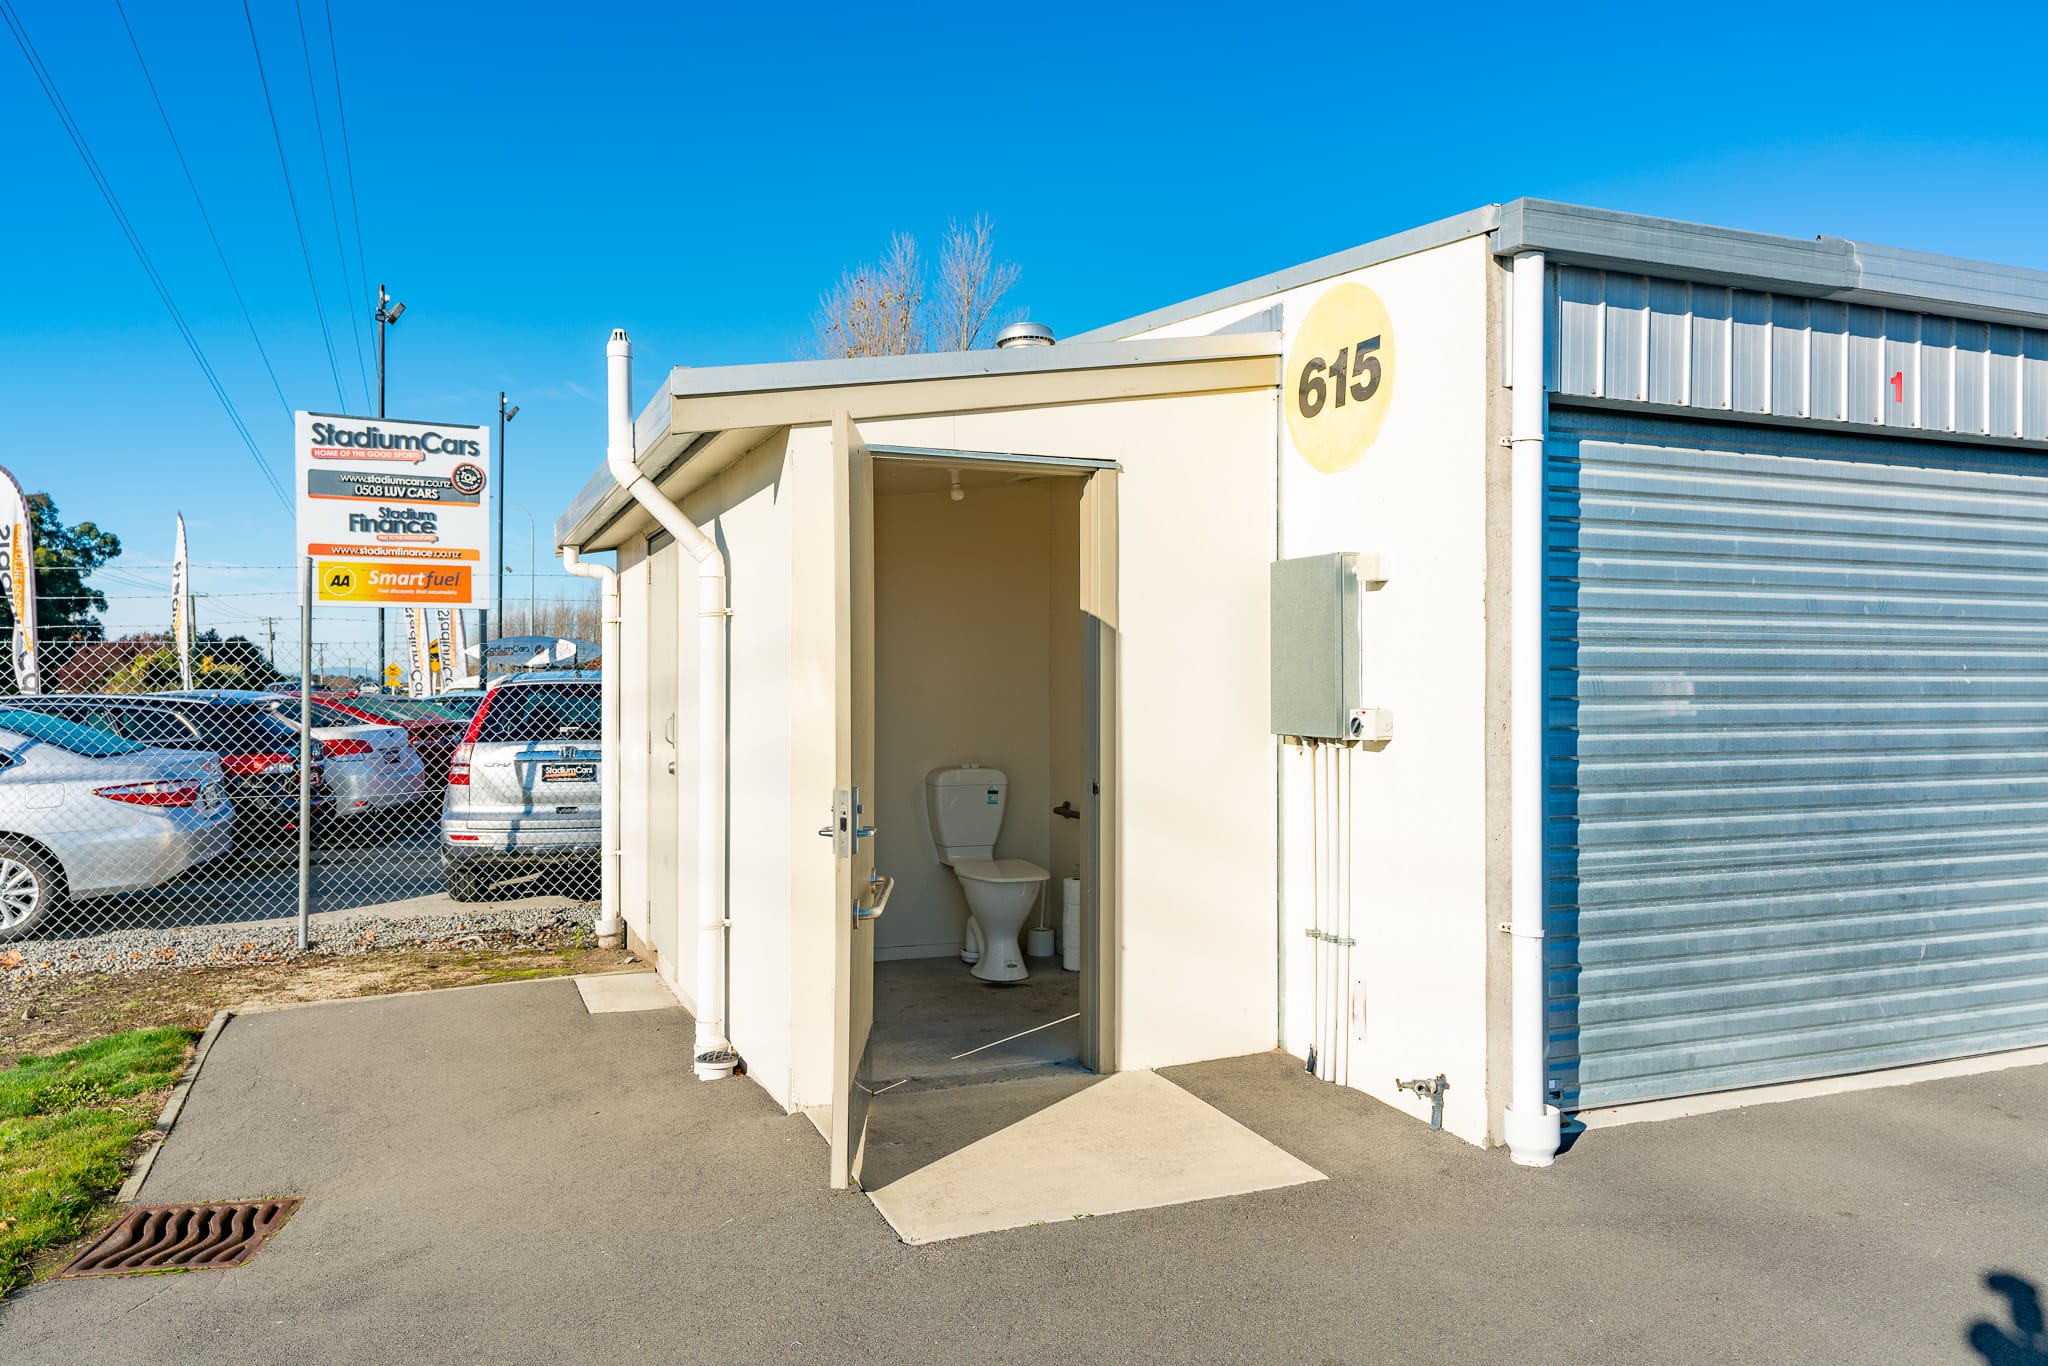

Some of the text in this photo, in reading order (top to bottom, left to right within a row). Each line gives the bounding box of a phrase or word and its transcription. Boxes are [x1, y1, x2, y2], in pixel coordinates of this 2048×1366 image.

[1298, 334, 1382, 419] 615
[1890, 371, 1903, 404] 1
[311, 422, 481, 457] StadiumCars
[314, 449, 338, 457] HOME
[352, 450, 366, 458] THE
[367, 450, 392, 458] GOOD
[394, 451, 421, 459] SPORTS
[340, 474, 451, 488] www.stadiumcars.co.nz
[461, 471, 477, 484] TOP
[355, 484, 439, 500] 0508 LUV CARS
[378, 507, 437, 521] Stadium
[349, 513, 437, 534] Finance
[332, 546, 461, 559] www.stadiumfinance.co.nz
[330, 575, 350, 587] AA
